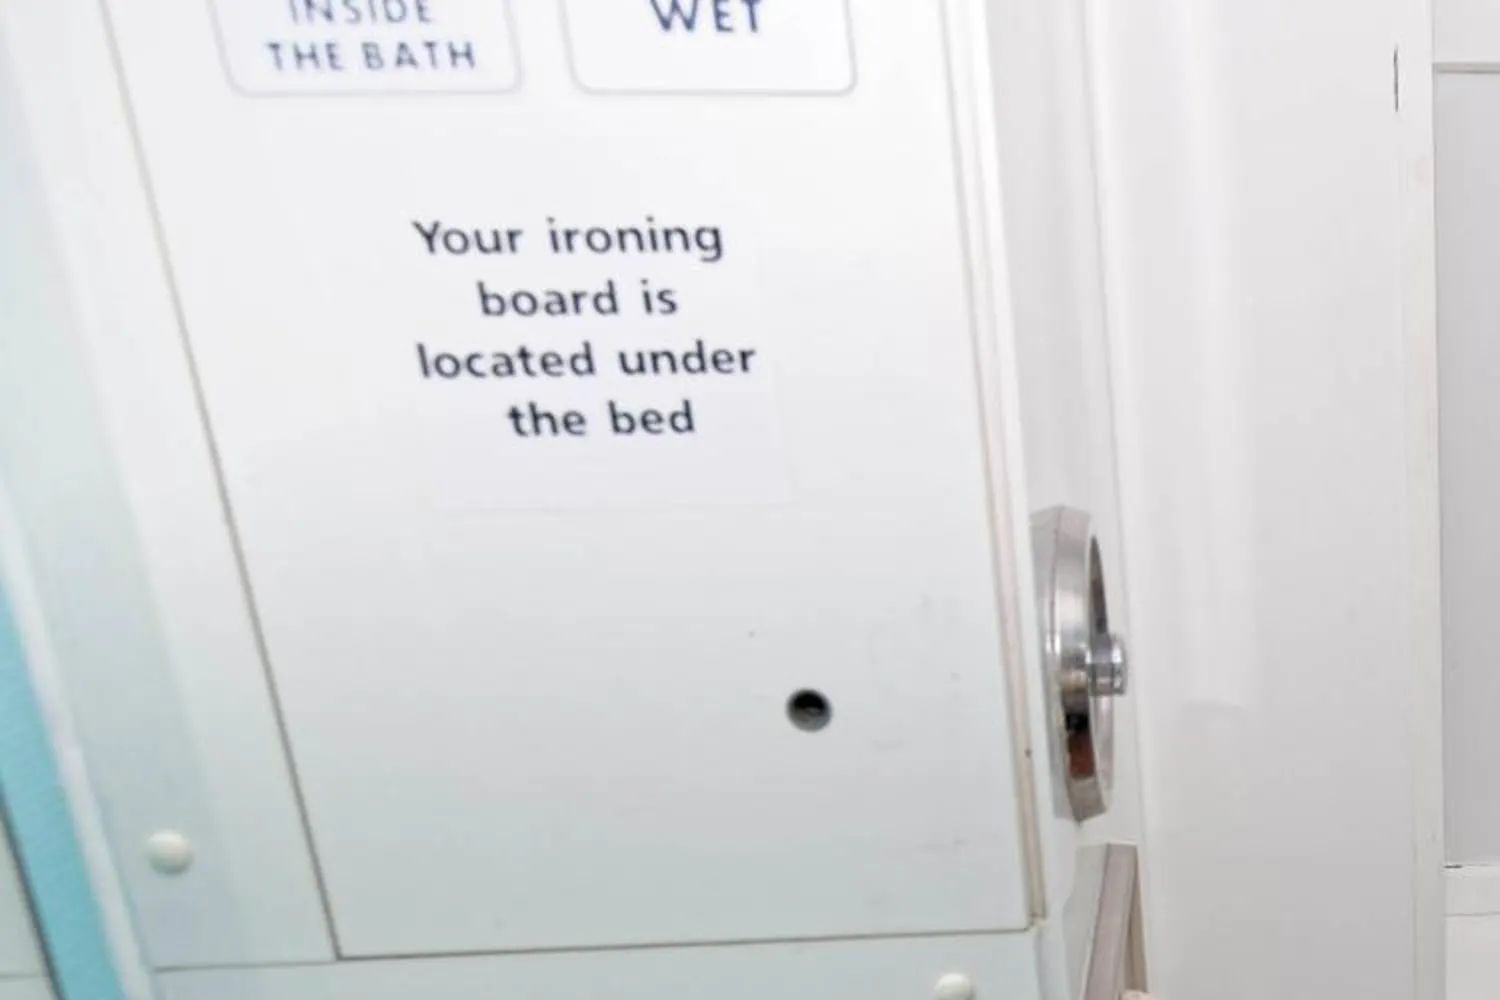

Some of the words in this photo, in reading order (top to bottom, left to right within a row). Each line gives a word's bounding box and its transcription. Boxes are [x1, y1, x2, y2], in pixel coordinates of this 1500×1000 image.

[289, 0, 432, 24] INSIDE
[650, 0, 763, 33] WET
[265, 41, 346, 71] THE
[361, 41, 477, 70] BATH
[412, 219, 524, 256] Your
[547, 216, 724, 263] ironing
[476, 280, 620, 318] board
[641, 280, 679, 317] is
[415, 340, 597, 380] located
[617, 339, 757, 377] under
[507, 402, 587, 438] the
[608, 400, 696, 436] bed
